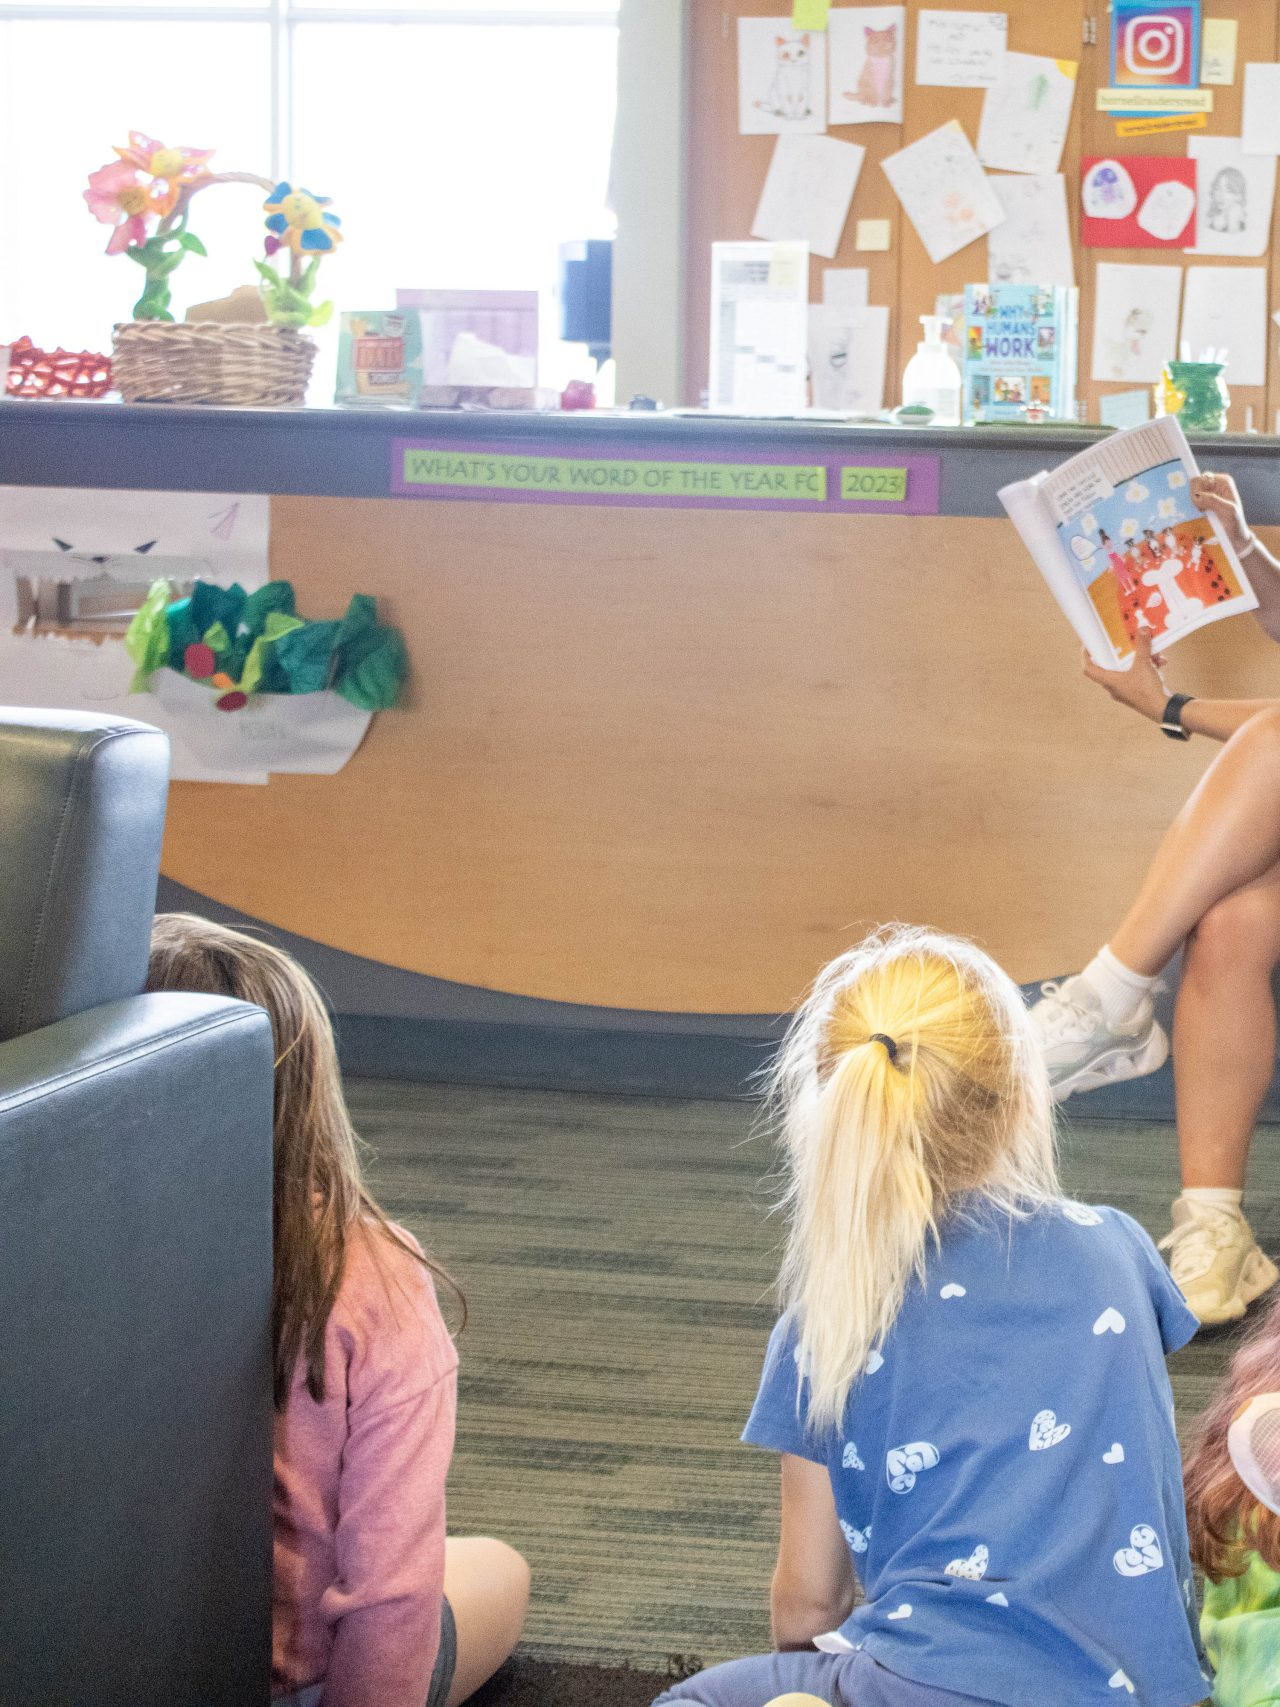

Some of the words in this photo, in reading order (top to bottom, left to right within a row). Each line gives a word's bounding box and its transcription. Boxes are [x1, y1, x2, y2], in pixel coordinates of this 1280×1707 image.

[999, 305, 1025, 318] WHY
[986, 321, 1036, 335] HUMANS
[985, 337, 1036, 358] WORK
[411, 457, 497, 481] WHAT'S
[501, 463, 562, 484] YOUR
[569, 466, 639, 487] WORD
[643, 469, 675, 487] OF
[679, 470, 723, 490] THE
[729, 472, 789, 491] YEAR
[846, 474, 902, 494] 2023
